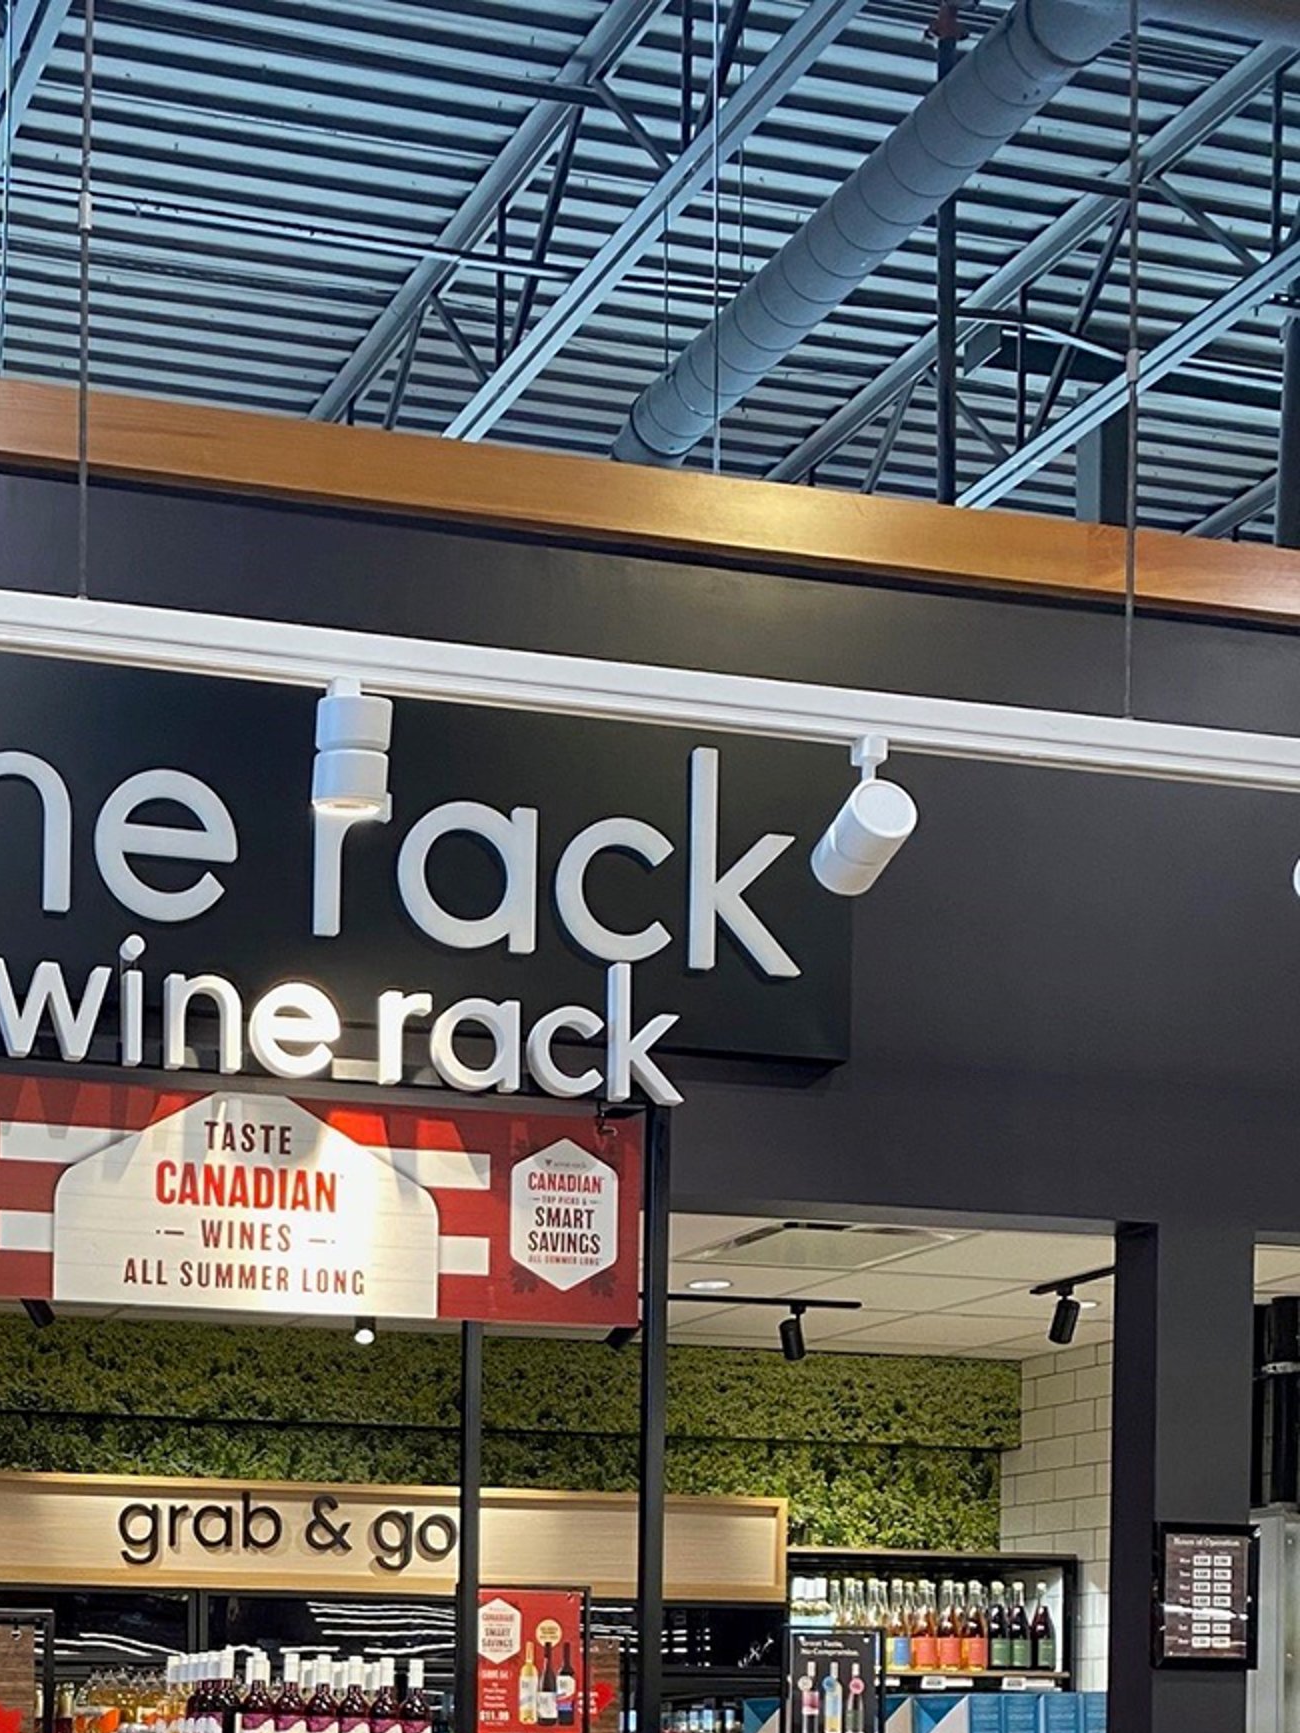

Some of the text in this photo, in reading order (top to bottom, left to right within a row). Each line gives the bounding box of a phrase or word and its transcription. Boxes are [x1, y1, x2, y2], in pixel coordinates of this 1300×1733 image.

[376, 962, 684, 1106] rack
[204, 1121, 293, 1155] TASTE
[535, 1205, 595, 1229] SMART
[201, 1219, 293, 1252] WINES
[528, 1230, 601, 1255] SAVINGS
[123, 1258, 365, 1295] ALL SUMMER LONG
[118, 1491, 458, 1571] grab & go
